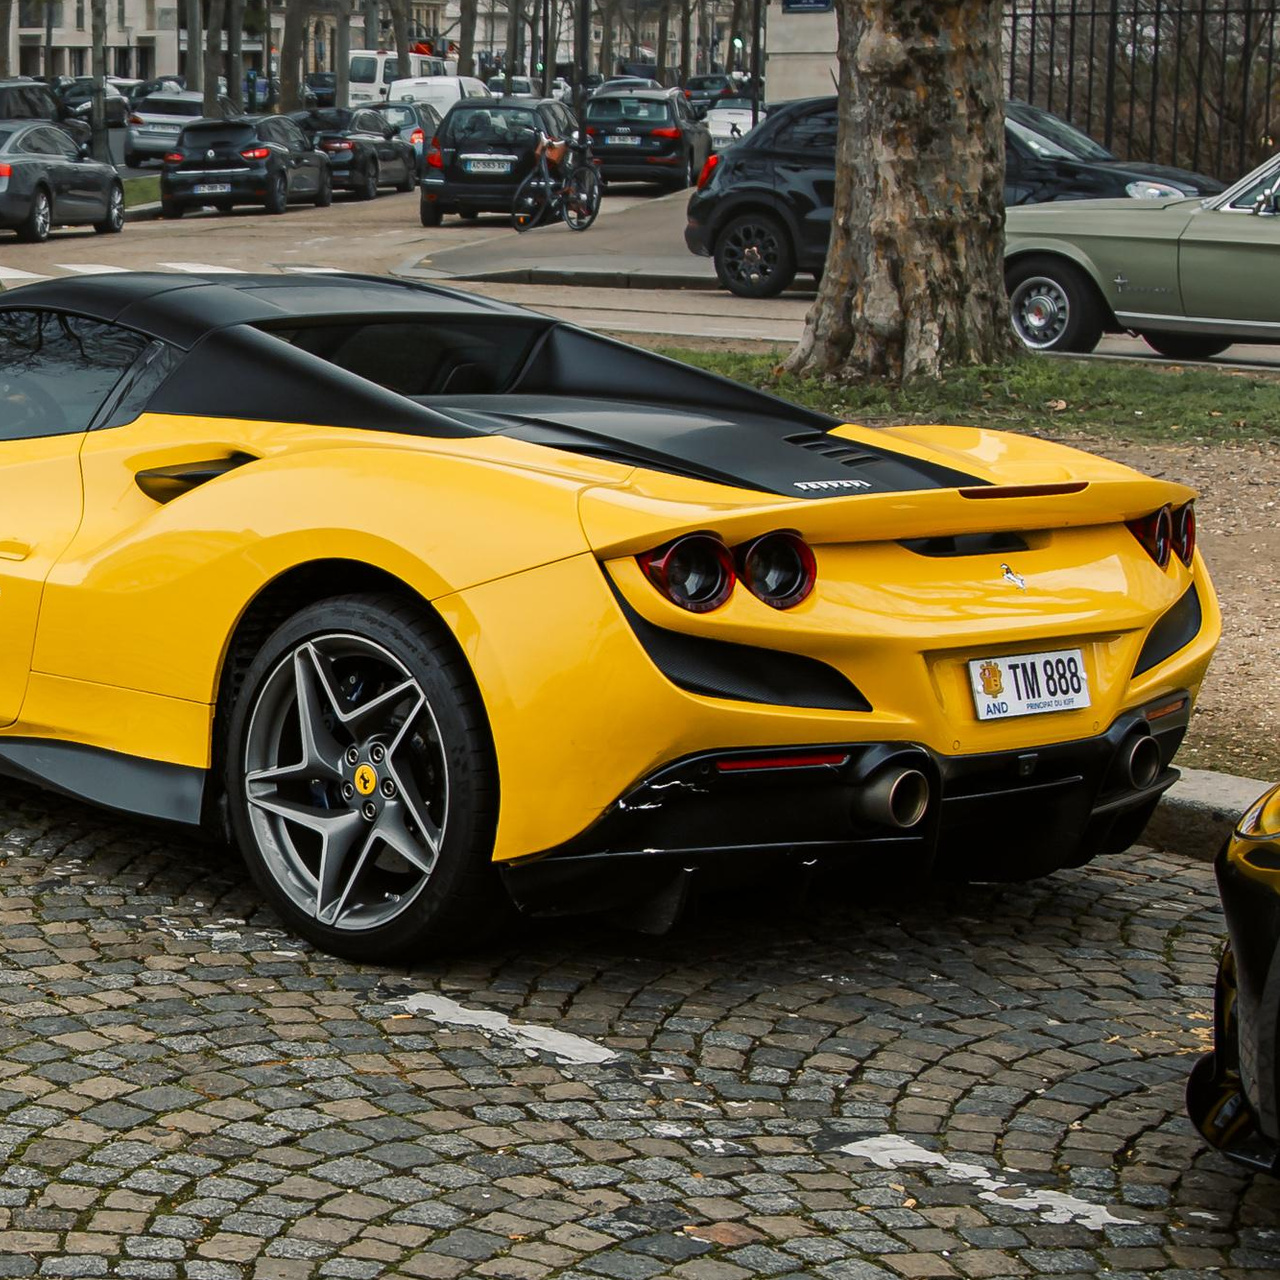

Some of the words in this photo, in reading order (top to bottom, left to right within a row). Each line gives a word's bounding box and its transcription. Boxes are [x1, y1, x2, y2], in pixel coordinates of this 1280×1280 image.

[1008, 661, 1041, 701] TM
[1043, 657, 1082, 697] 888
[986, 701, 1009, 715] AND
[1054, 699, 1063, 707] DU
